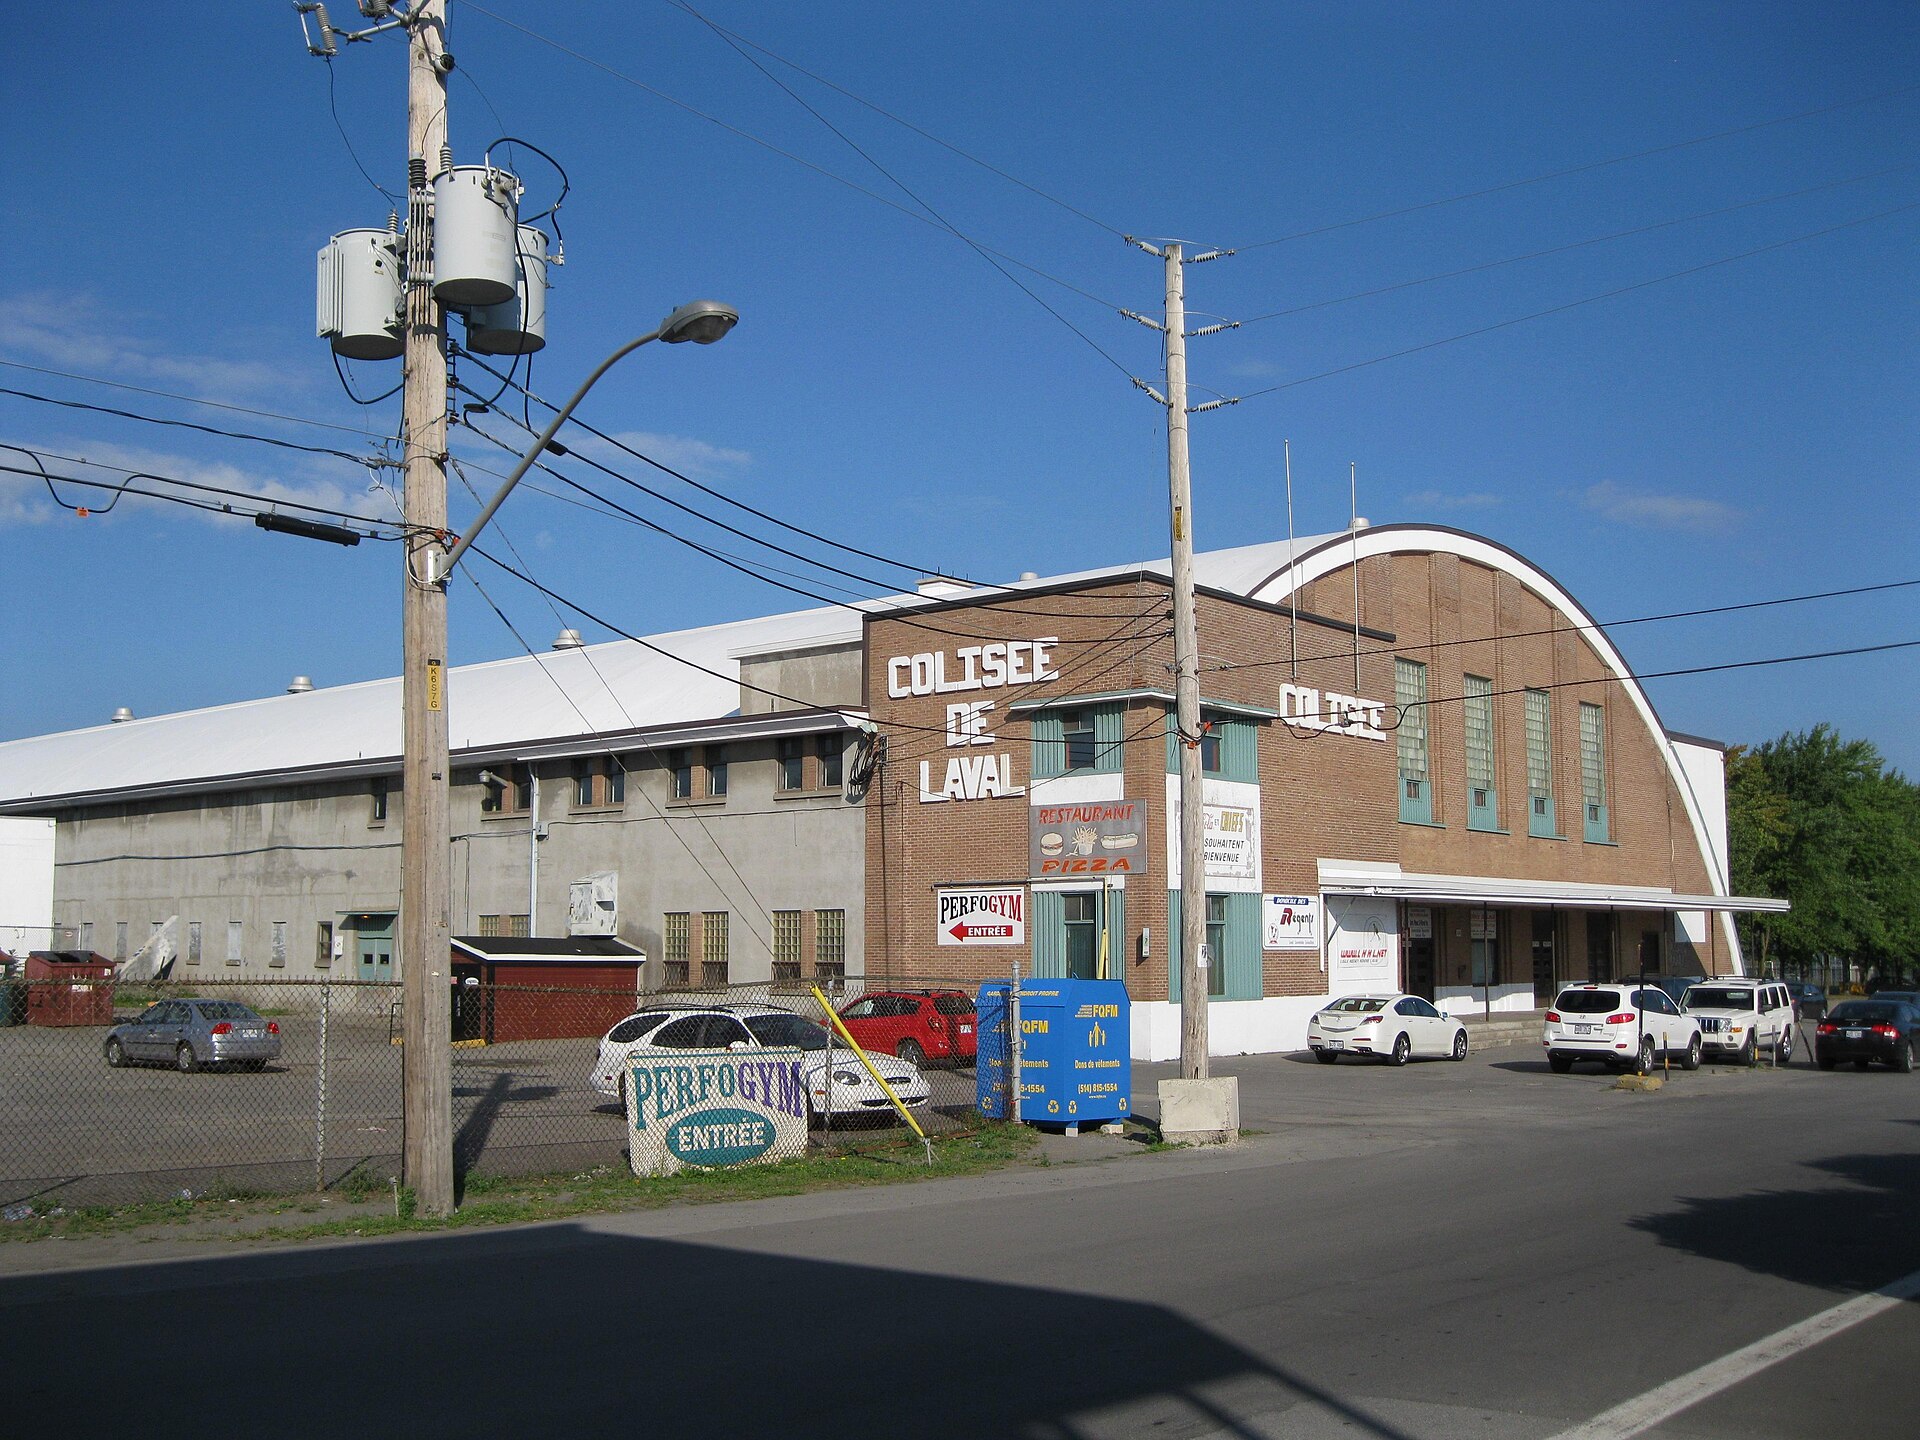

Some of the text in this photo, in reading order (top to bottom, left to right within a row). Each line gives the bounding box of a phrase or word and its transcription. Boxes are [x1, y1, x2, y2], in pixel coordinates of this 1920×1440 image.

[888, 637, 1059, 699] COLISEE
[430, 668, 438, 708] K6S7G
[946, 701, 995, 747] DE
[919, 754, 1025, 803] LAVAL
[1039, 803, 1135, 824] RESTAURANT
[1204, 838, 1244, 849] SOUHAITENT
[1041, 857, 1130, 873] PIZZA
[1203, 851, 1240, 862] BIENVENUE
[940, 895, 1022, 924] PERFOGYM
[968, 925, 1007, 936] ENTRÉE
[1093, 1005, 1118, 1017] FQFM
[1020, 1020, 1049, 1034] QFM
[1075, 1060, 1087, 1068] Dons
[1088, 1060, 1094, 1068] de
[632, 1061, 803, 1130] PERFOGYM
[678, 1117, 765, 1152] ENTRÉE
